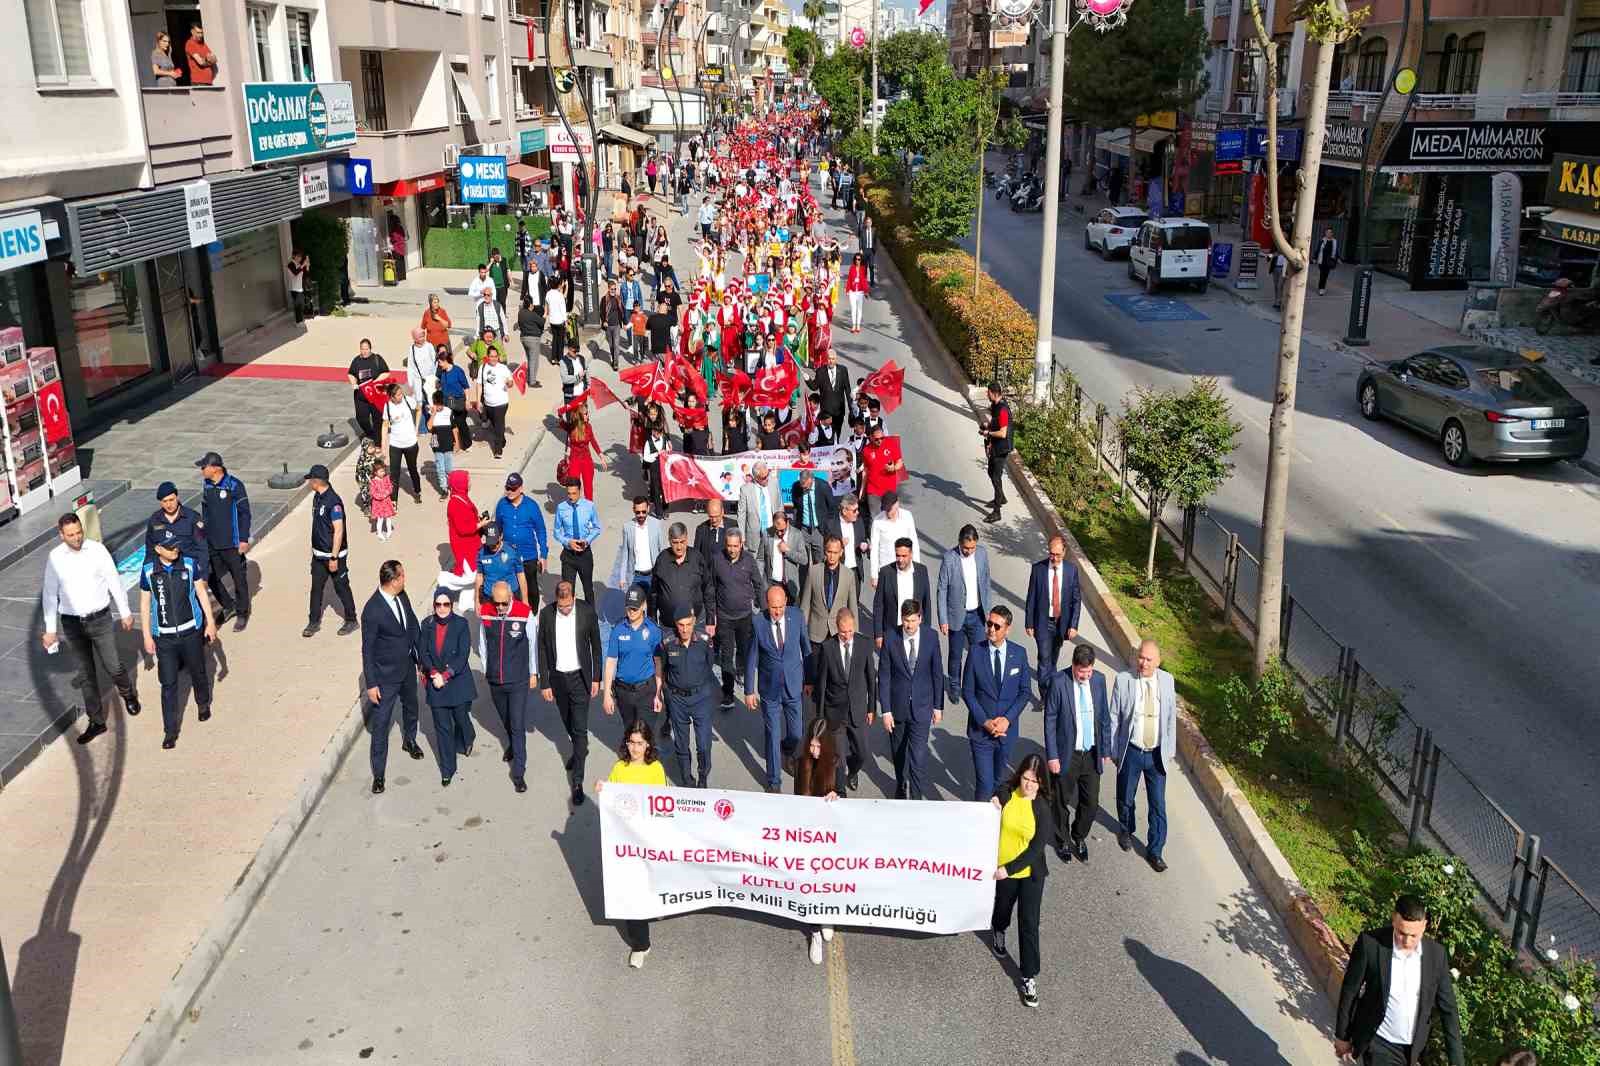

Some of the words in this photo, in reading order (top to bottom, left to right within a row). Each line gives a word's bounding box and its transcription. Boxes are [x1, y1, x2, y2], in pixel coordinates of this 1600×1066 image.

[248, 91, 307, 124] DOĞANAY
[1413, 135, 1463, 153] MEDA
[1469, 124, 1546, 146] MİMARLIK
[1467, 147, 1544, 160] DEKORASYON
[0, 225, 40, 258] ENS
[1561, 227, 1600, 245] KASAP
[158, 585, 168, 625] ZABITA
[647, 795, 675, 816] 100
[762, 828, 780, 841] 23
[785, 828, 837, 844] NİSAN
[615, 845, 678, 862] ULUSAL
[683, 849, 779, 869] EGEMENLİK
[784, 857, 805, 871] VE
[810, 857, 869, 874] ÇOCUK
[874, 857, 983, 881] BAYRAMIMIZ
[742, 874, 795, 891] KUTLU
[799, 882, 857, 895] OLSUN
[659, 889, 713, 905] Tarsus
[717, 886, 745, 902] İlçe
[750, 892, 783, 908] Milli
[788, 900, 840, 917] Eğitim
[846, 903, 937, 925] Müdürlüğü
